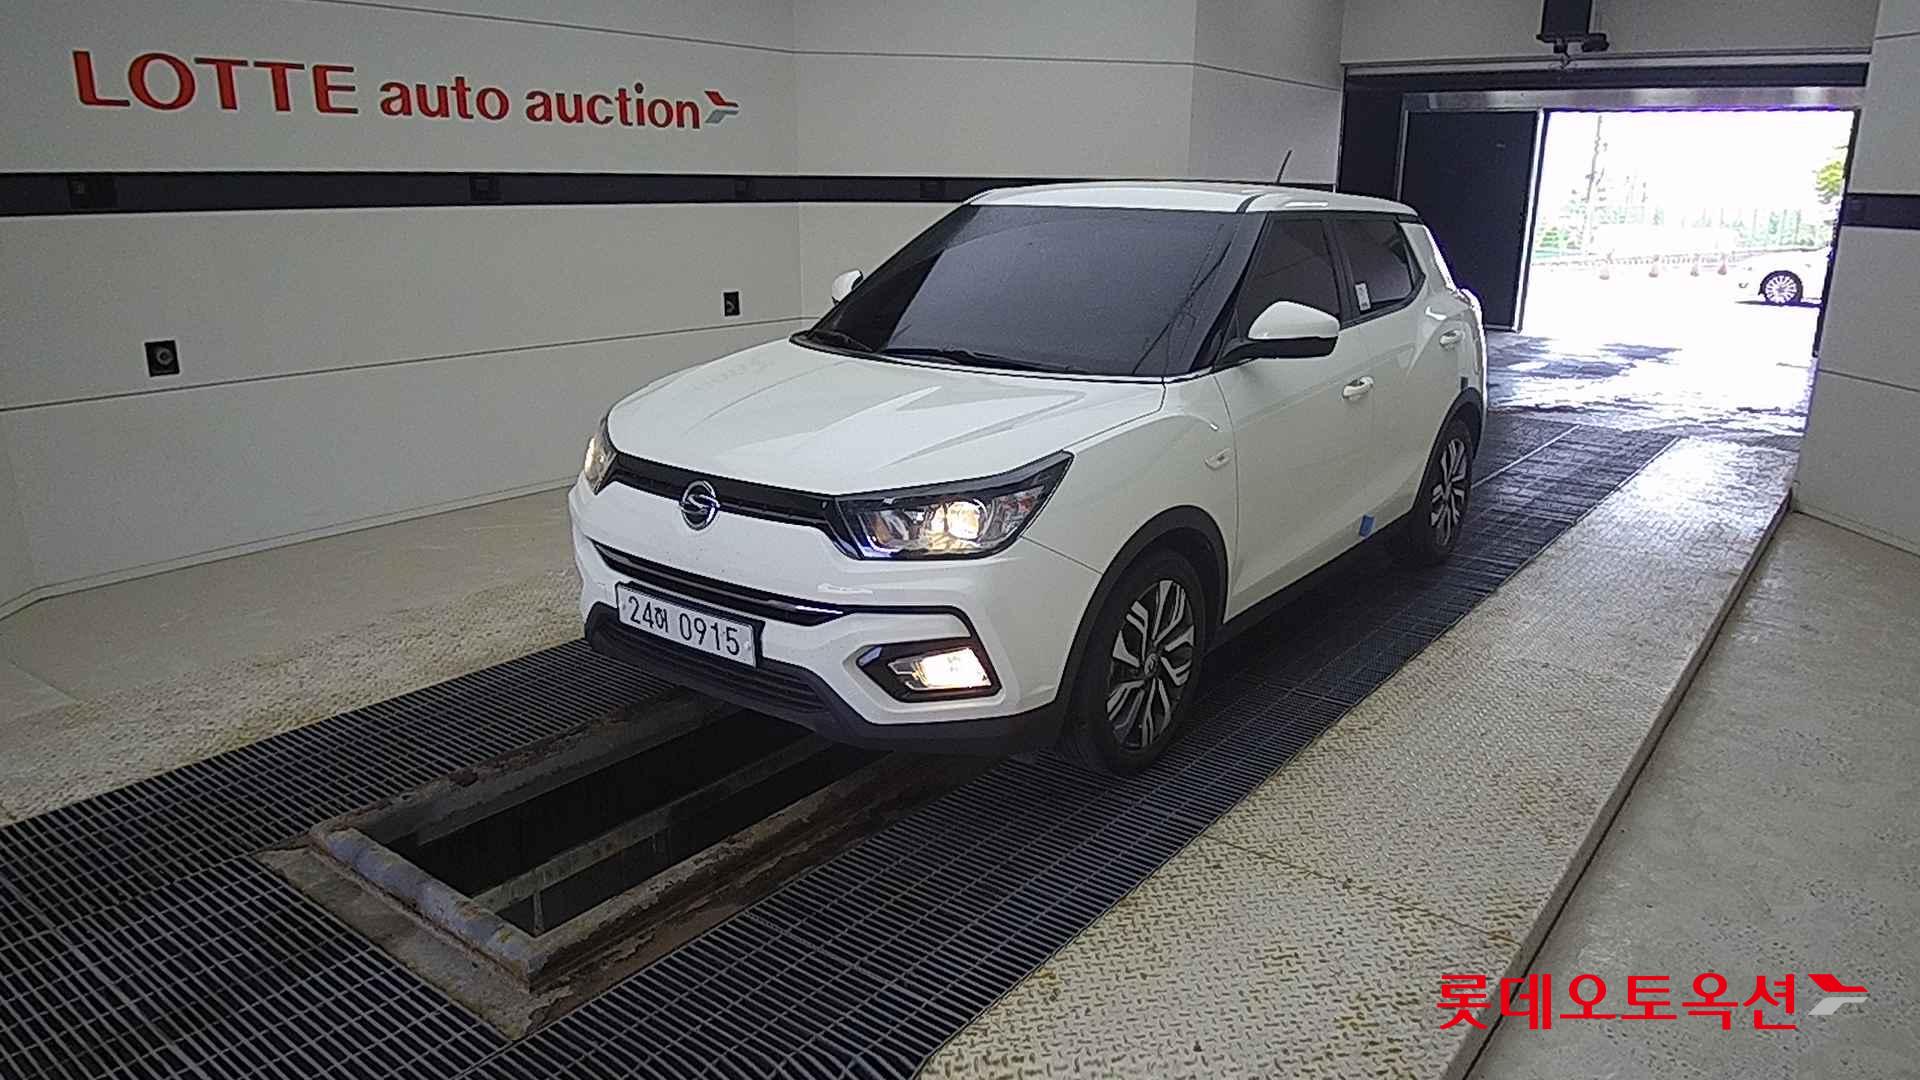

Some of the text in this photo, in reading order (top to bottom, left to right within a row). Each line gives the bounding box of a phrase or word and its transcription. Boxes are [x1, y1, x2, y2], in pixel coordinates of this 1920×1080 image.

[72, 50, 702, 130] LOTTE auto auction
[679, 613, 740, 655] 0915
